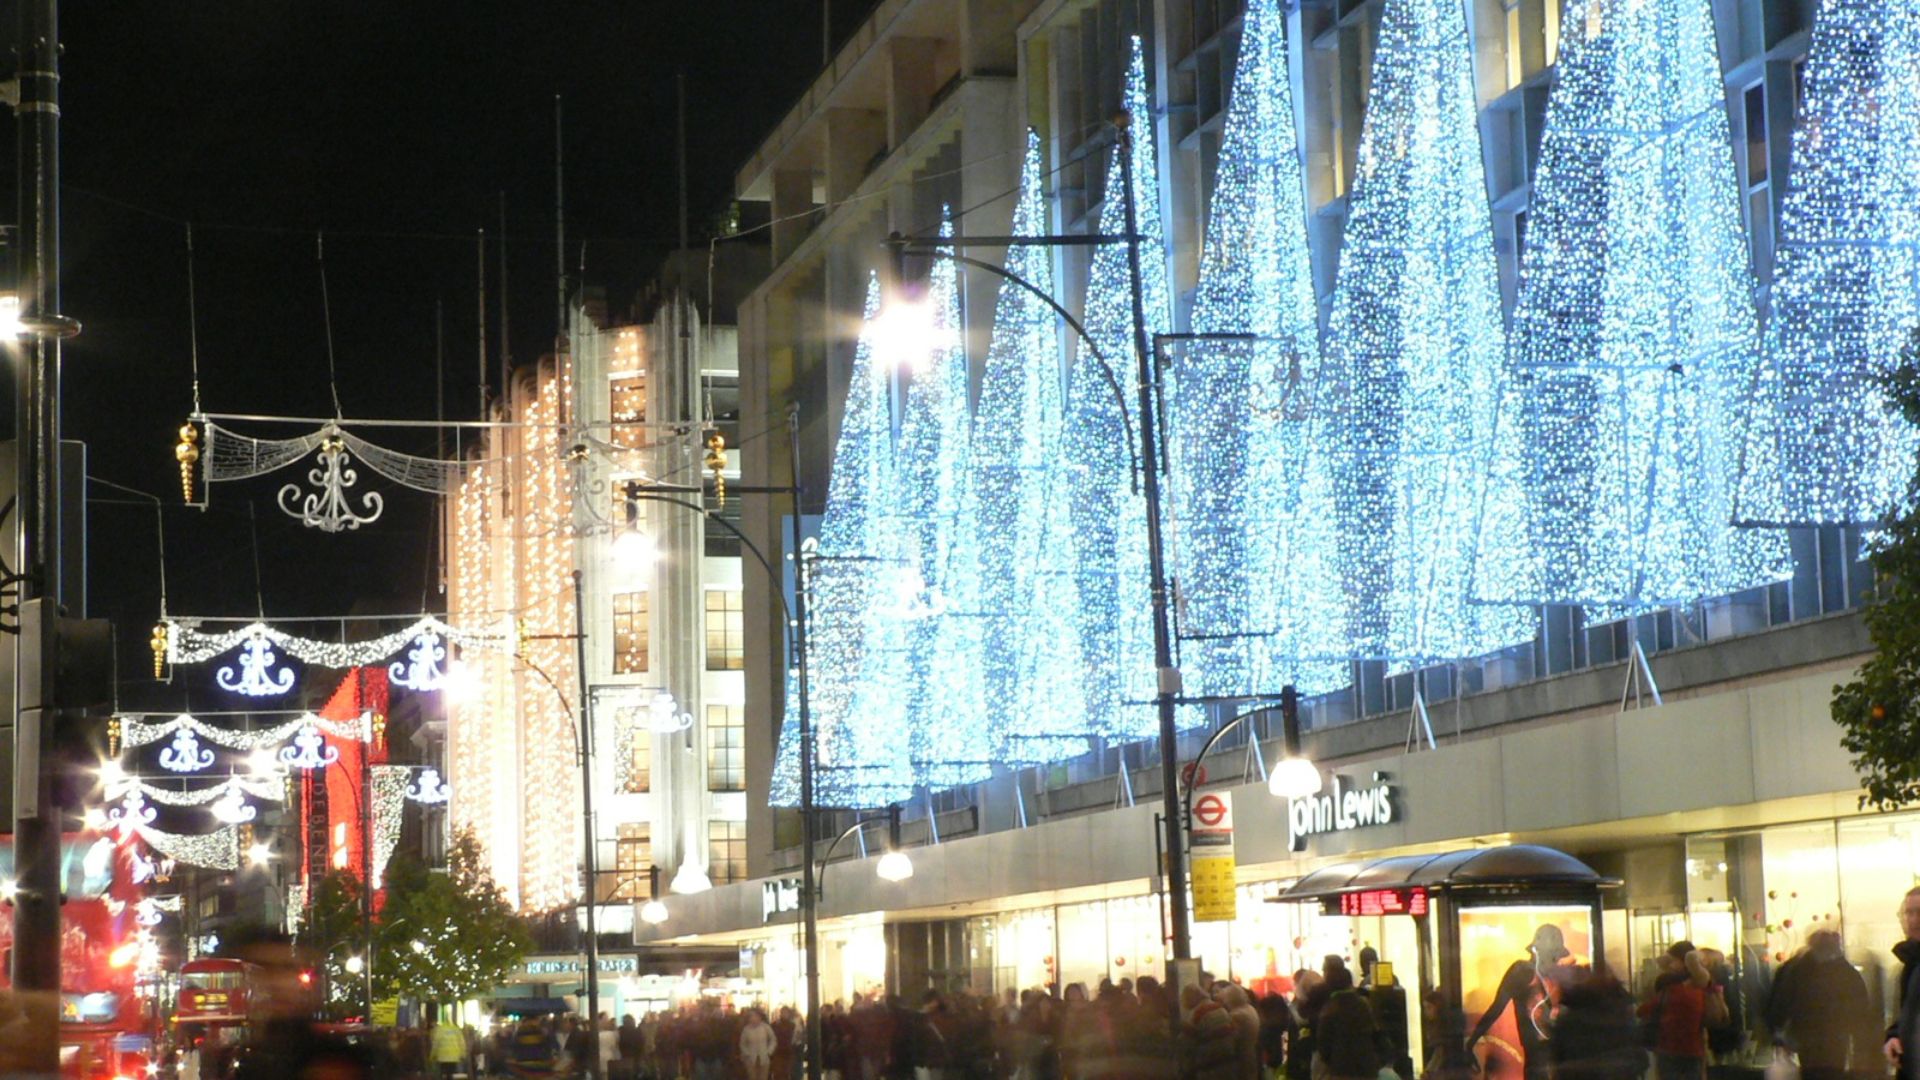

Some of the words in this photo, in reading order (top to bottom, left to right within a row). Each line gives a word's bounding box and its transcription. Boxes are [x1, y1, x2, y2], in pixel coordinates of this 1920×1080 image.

[311, 783, 326, 876] DEBENH
[1287, 793, 1331, 852] John
[1334, 770, 1391, 830] Lewis
[597, 958, 637, 973] RASER
